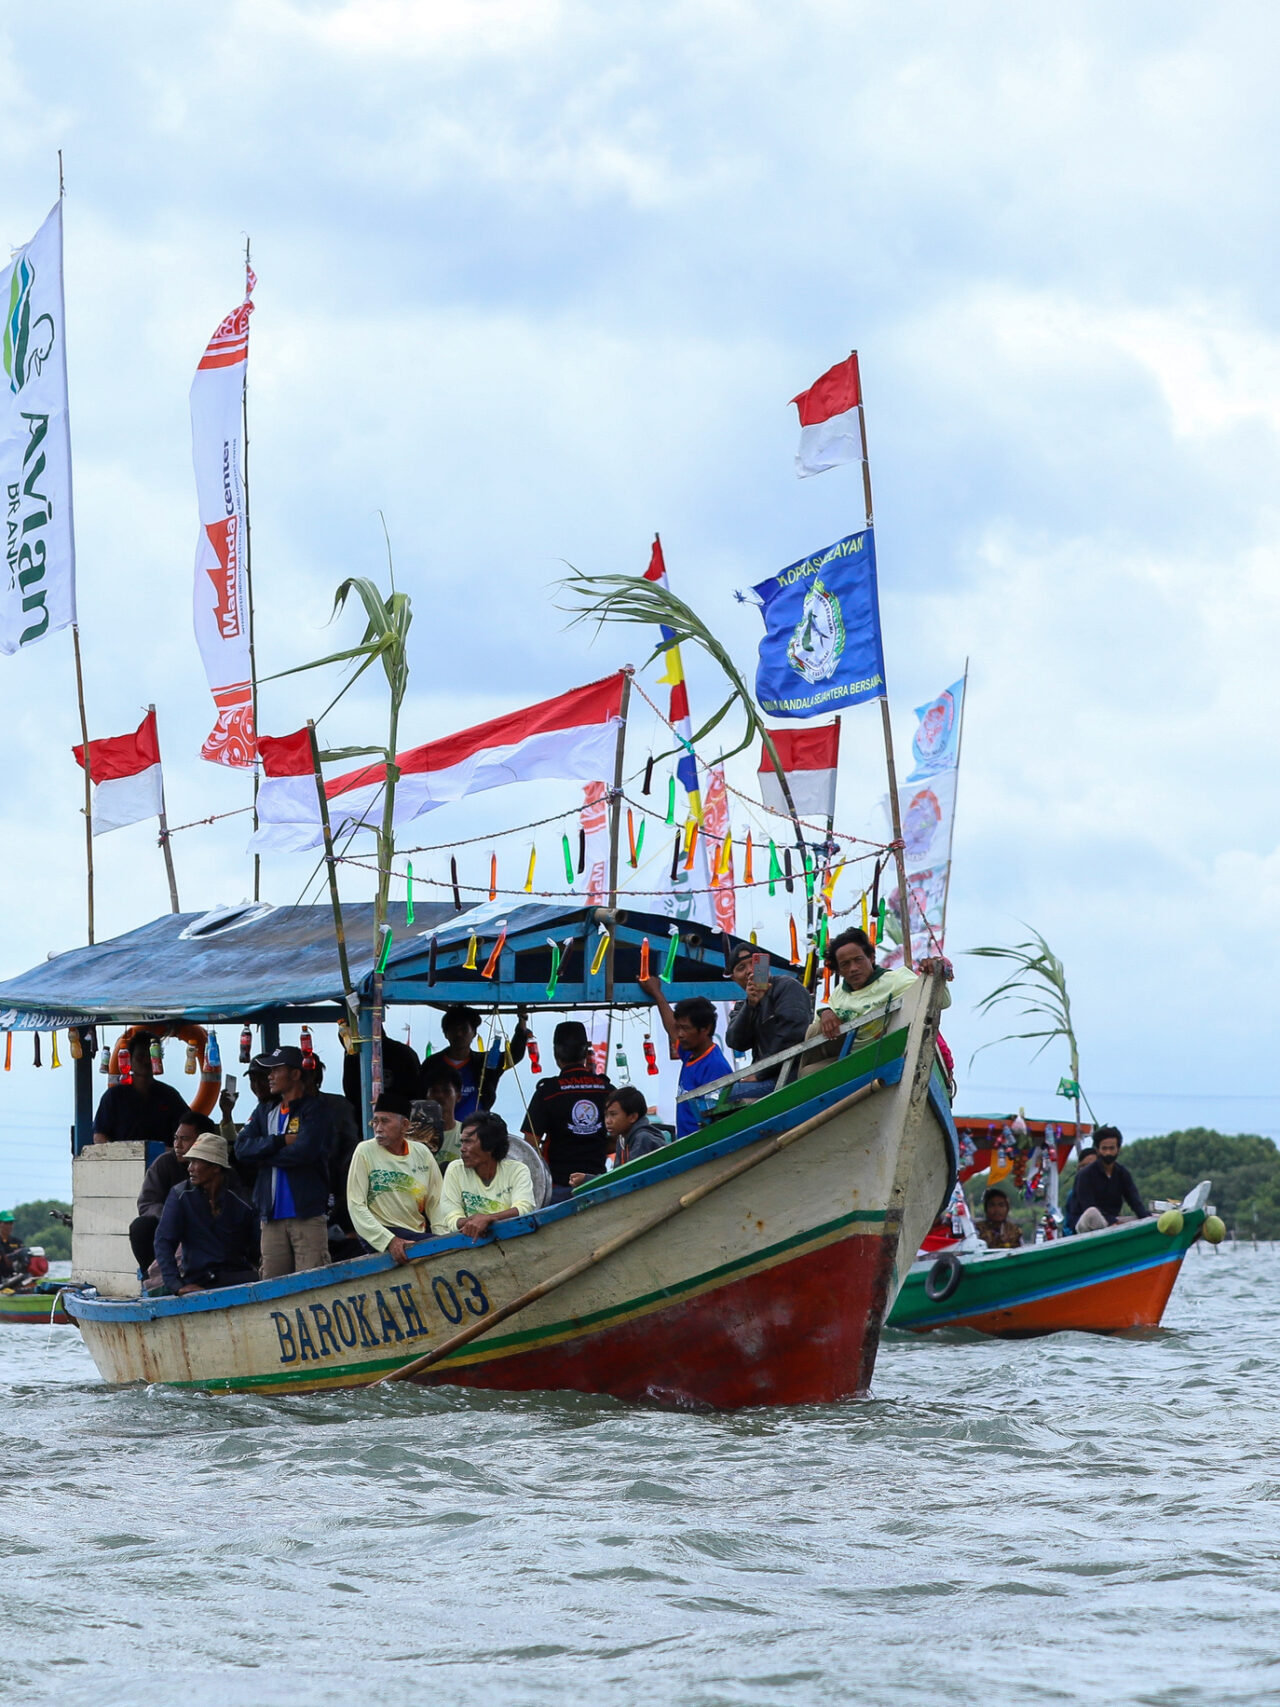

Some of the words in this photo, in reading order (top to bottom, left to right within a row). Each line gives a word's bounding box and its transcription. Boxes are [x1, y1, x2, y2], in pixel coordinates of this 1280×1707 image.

[19, 411, 53, 647] Avian
[223, 440, 234, 516] center
[222, 518, 237, 635] Marunda
[271, 1283, 429, 1363] BAROKAH
[432, 1269, 490, 1324] 03
